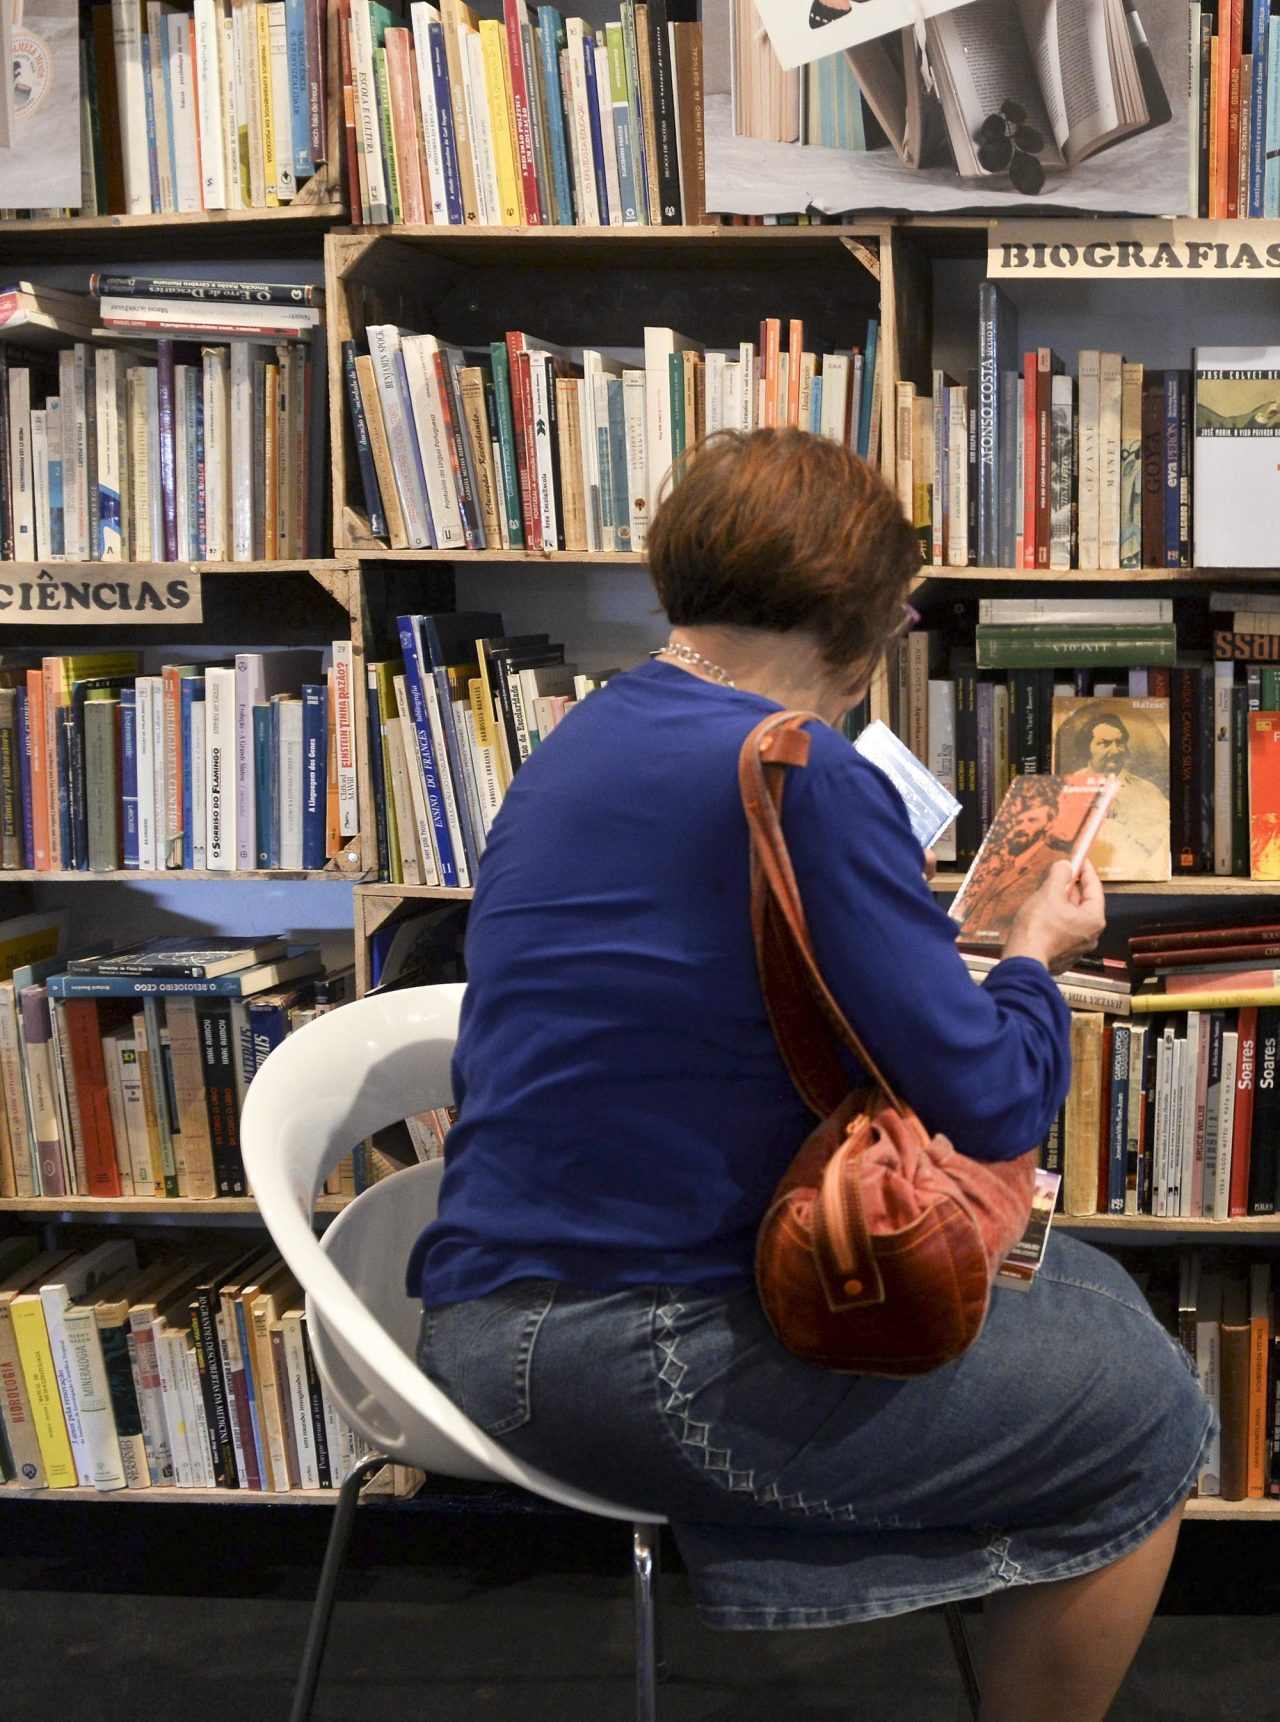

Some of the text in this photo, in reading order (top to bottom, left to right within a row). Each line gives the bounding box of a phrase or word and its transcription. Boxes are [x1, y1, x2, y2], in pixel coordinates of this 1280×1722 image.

[375, 330, 394, 388] BENJAMIN SPOCK
[985, 321, 993, 356] SÉCULO XX
[1202, 370, 1223, 379] JOSÉ
[1230, 371, 1262, 379] CALVET
[1268, 371, 1277, 379] DE
[981, 360, 993, 464] AFONSO COSTA
[1106, 439, 1115, 487] MANET
[1145, 431, 1162, 494] GOYA
[1166, 423, 1178, 487] eva PERÓN
[0, 569, 190, 610] CIÊNCIAS
[336, 662, 353, 768] EINSTEIN TINHA RAZÃO?
[212, 748, 221, 794] FLAMINGO
[410, 685, 443, 827] ENSINO DO FRANCÊS bibliografia
[213, 796, 219, 808] DO
[309, 774, 319, 806] Linguagem
[212, 811, 221, 849] SORRISO
[134, 983, 216, 992] O RELOJOEIRO CEGO
[1238, 1040, 1254, 1089] Soares
[1260, 1038, 1276, 1088] Soares
[1196, 1105, 1205, 1161] BRUCE WILLIS
[1, 1361, 24, 1424] HIDROLOGIA
[74, 1345, 95, 1397] MINERALOGIA
